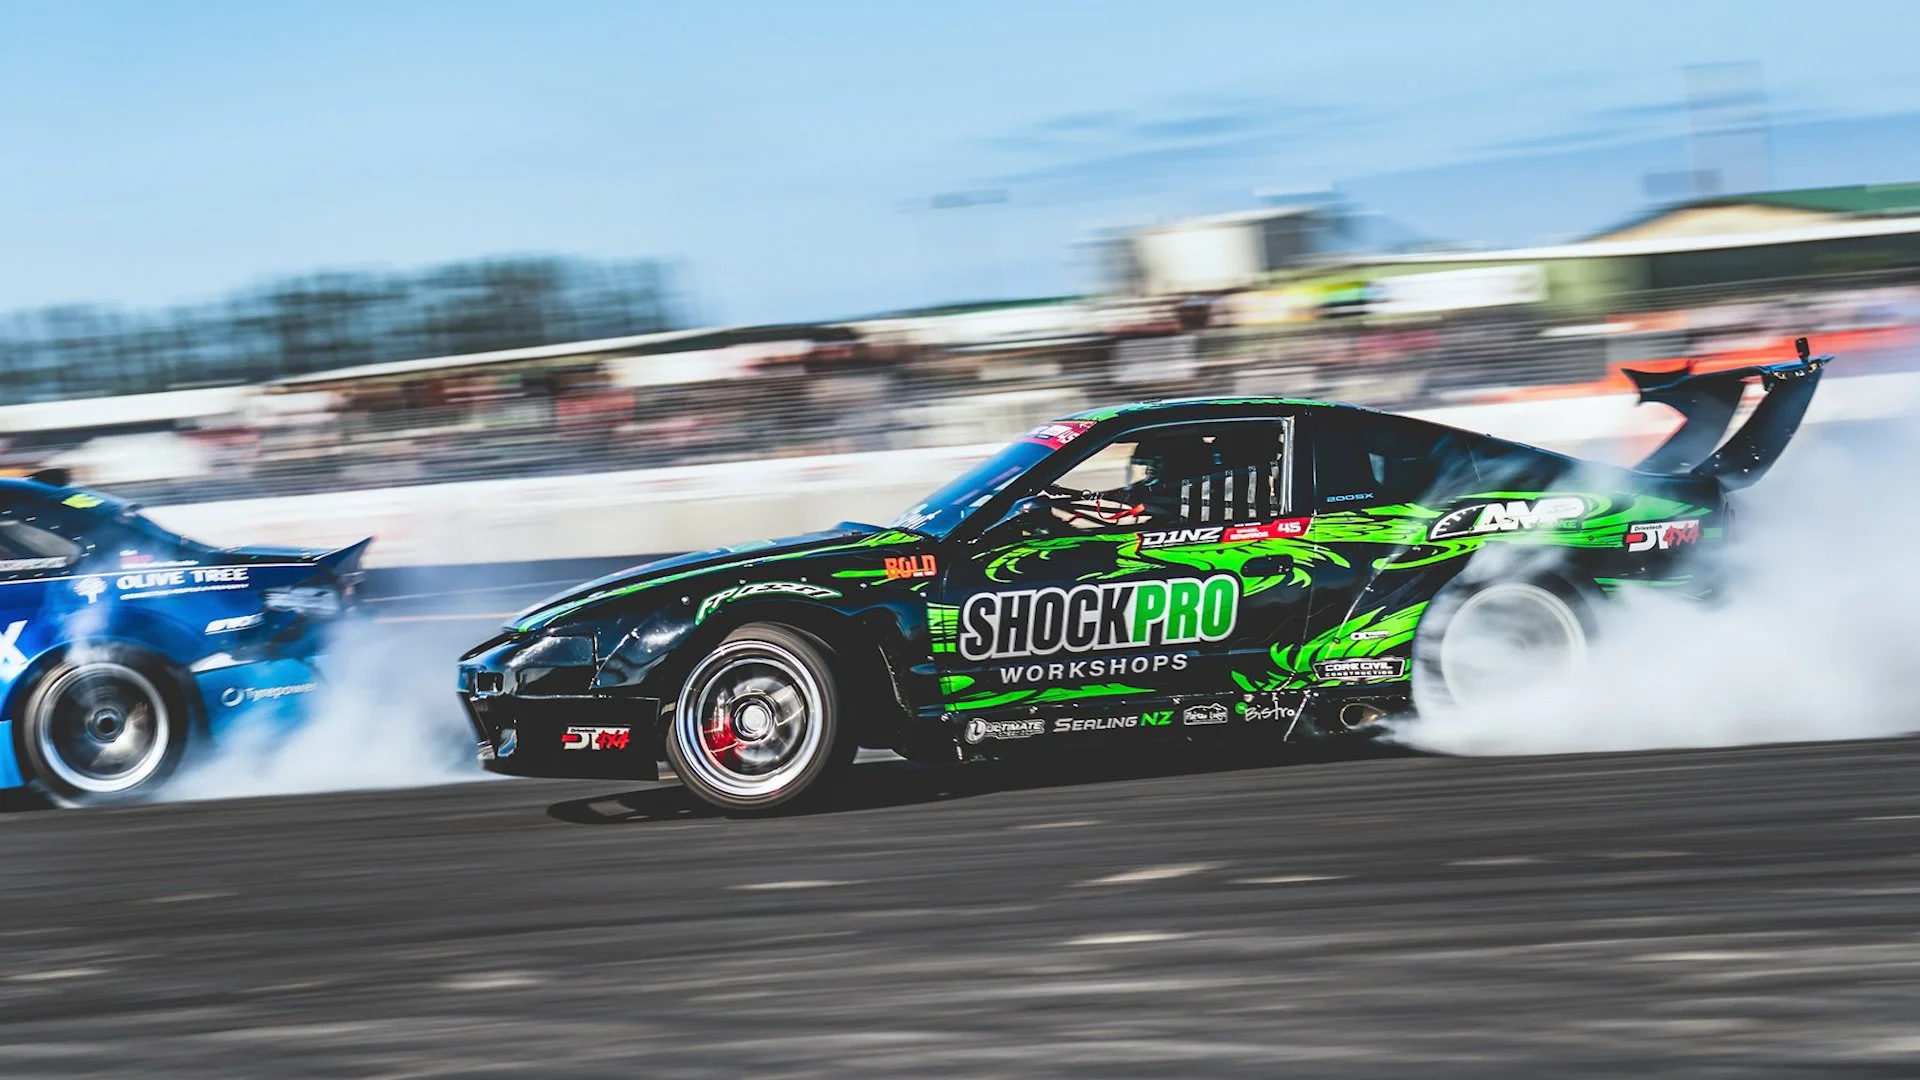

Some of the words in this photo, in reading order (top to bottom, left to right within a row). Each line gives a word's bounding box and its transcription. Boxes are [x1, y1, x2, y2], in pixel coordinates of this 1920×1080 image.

[1143, 527, 1223, 546] D1NZ
[1277, 521, 1301, 534] 45
[883, 554, 937, 578] BOLD
[116, 570, 185, 590] OLIVE
[190, 568, 249, 583] TREE
[960, 574, 1240, 661] SHOCKPRO
[1001, 653, 1188, 684] WORKSHOPS
[1325, 662, 1359, 672] CORE
[1360, 662, 1393, 670] CIVIL
[1140, 711, 1175, 726] NZ
[1245, 701, 1295, 721] Bistro
